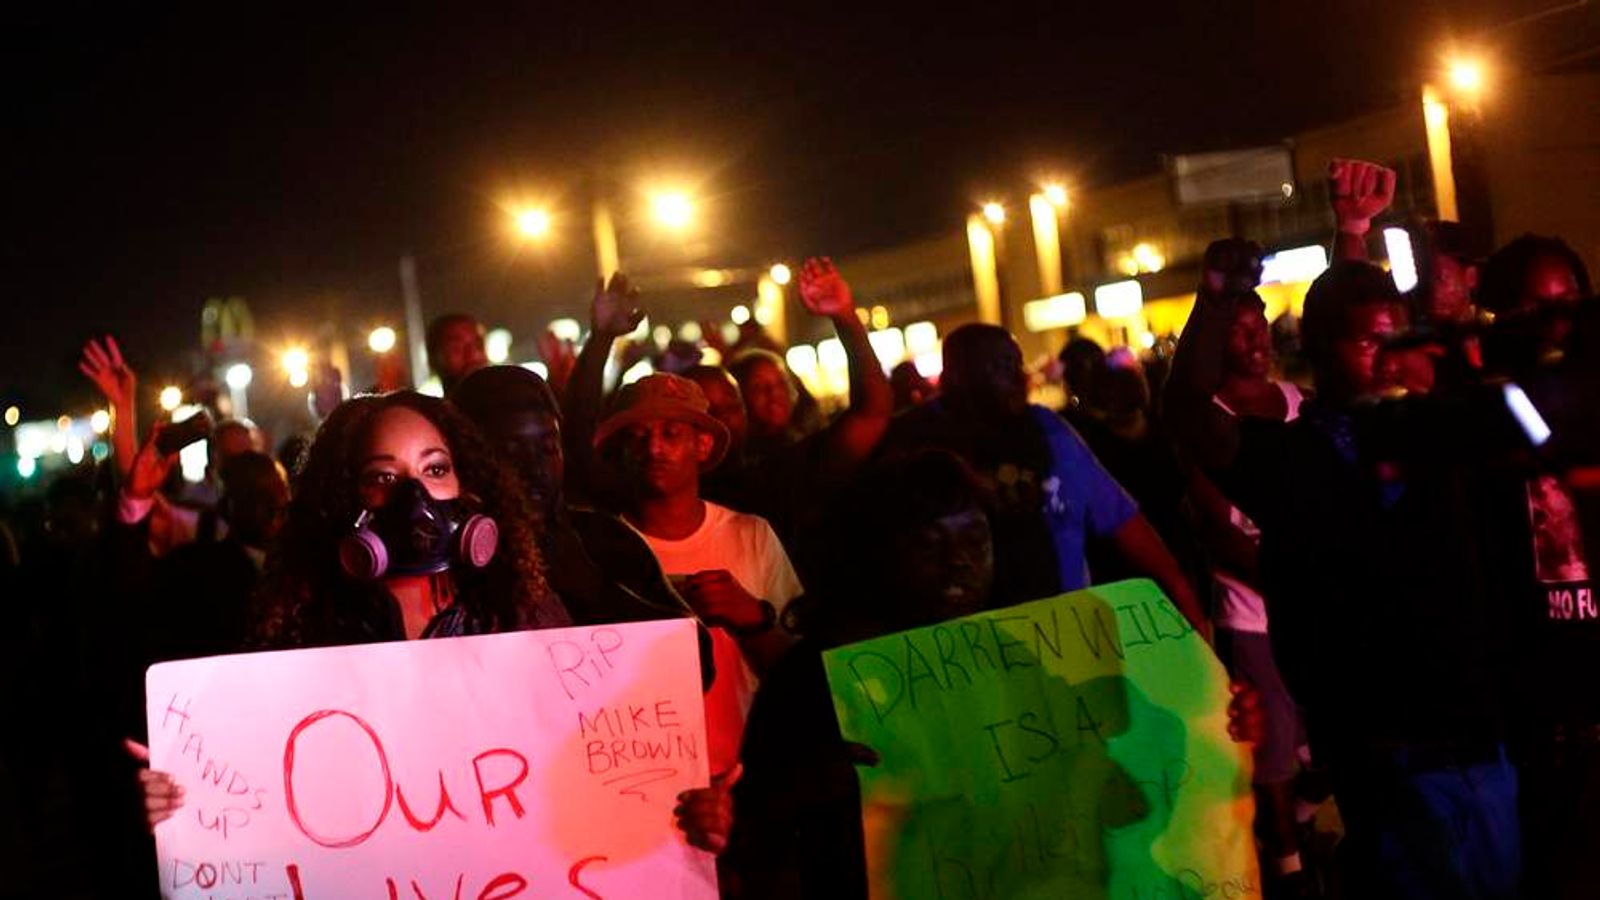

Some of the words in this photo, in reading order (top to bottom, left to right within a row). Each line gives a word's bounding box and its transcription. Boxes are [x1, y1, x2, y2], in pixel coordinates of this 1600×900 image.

[848, 609, 1062, 724] DARREN
[162, 693, 268, 810] HANDS
[578, 700, 680, 738] MIKE
[585, 733, 698, 775] BROWN
[984, 711, 1060, 783] IS
[1075, 696, 1109, 750] A
